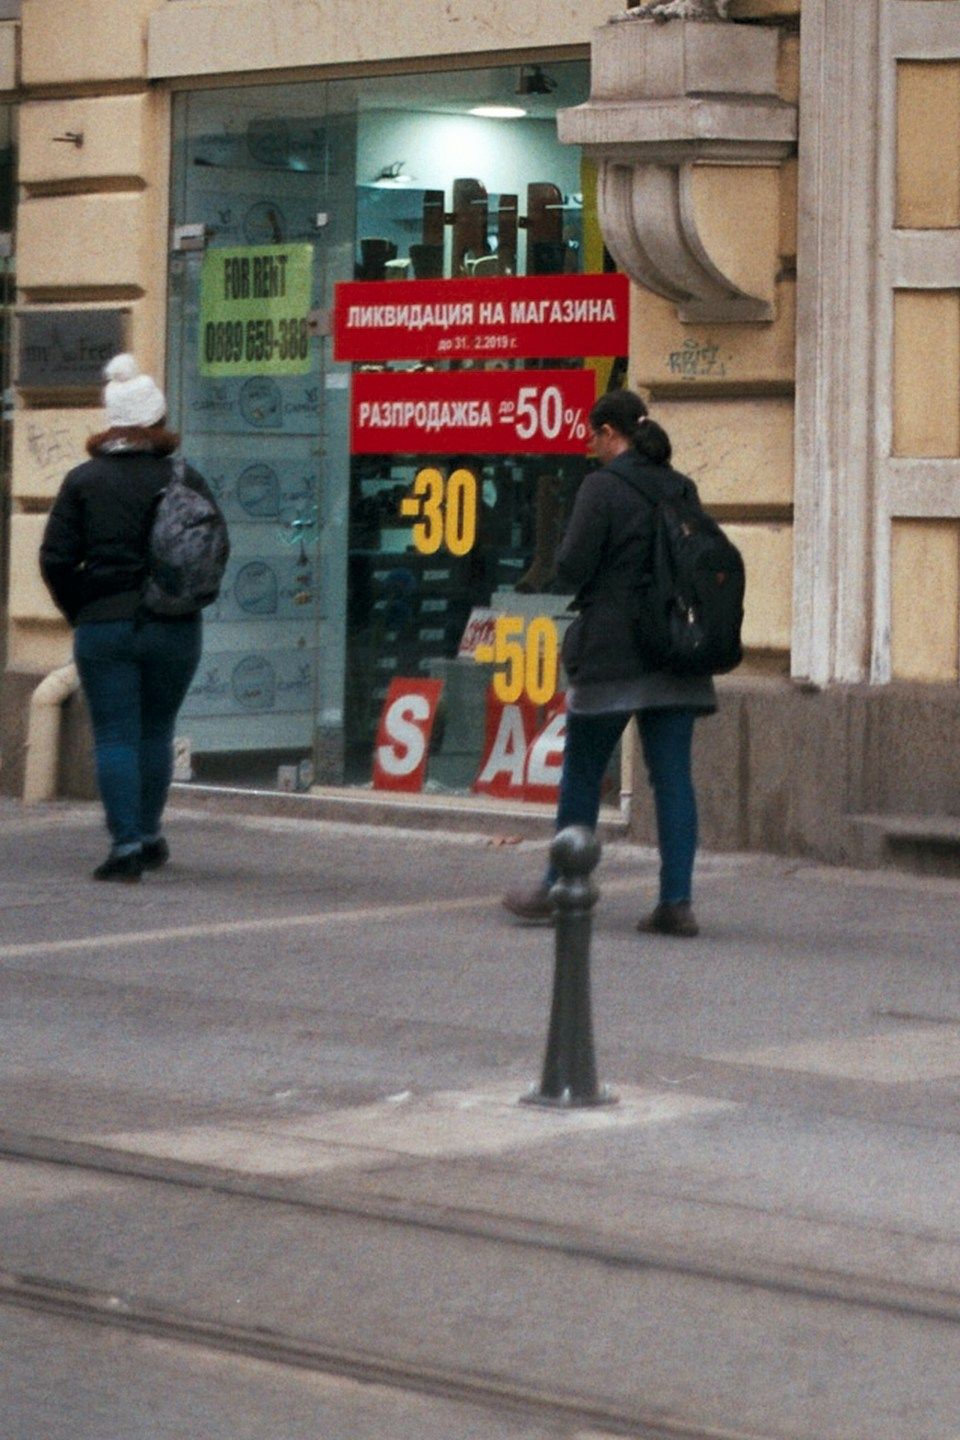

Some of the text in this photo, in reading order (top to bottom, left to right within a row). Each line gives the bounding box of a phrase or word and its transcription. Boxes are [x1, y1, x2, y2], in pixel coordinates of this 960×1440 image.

[224, 254, 288, 300] FOR RENT
[346, 298, 617, 331] ЛИКВИДАЦИЯ НА МАГАЗИНА
[359, 401, 493, 432] РАЗПРОДАЖБА
